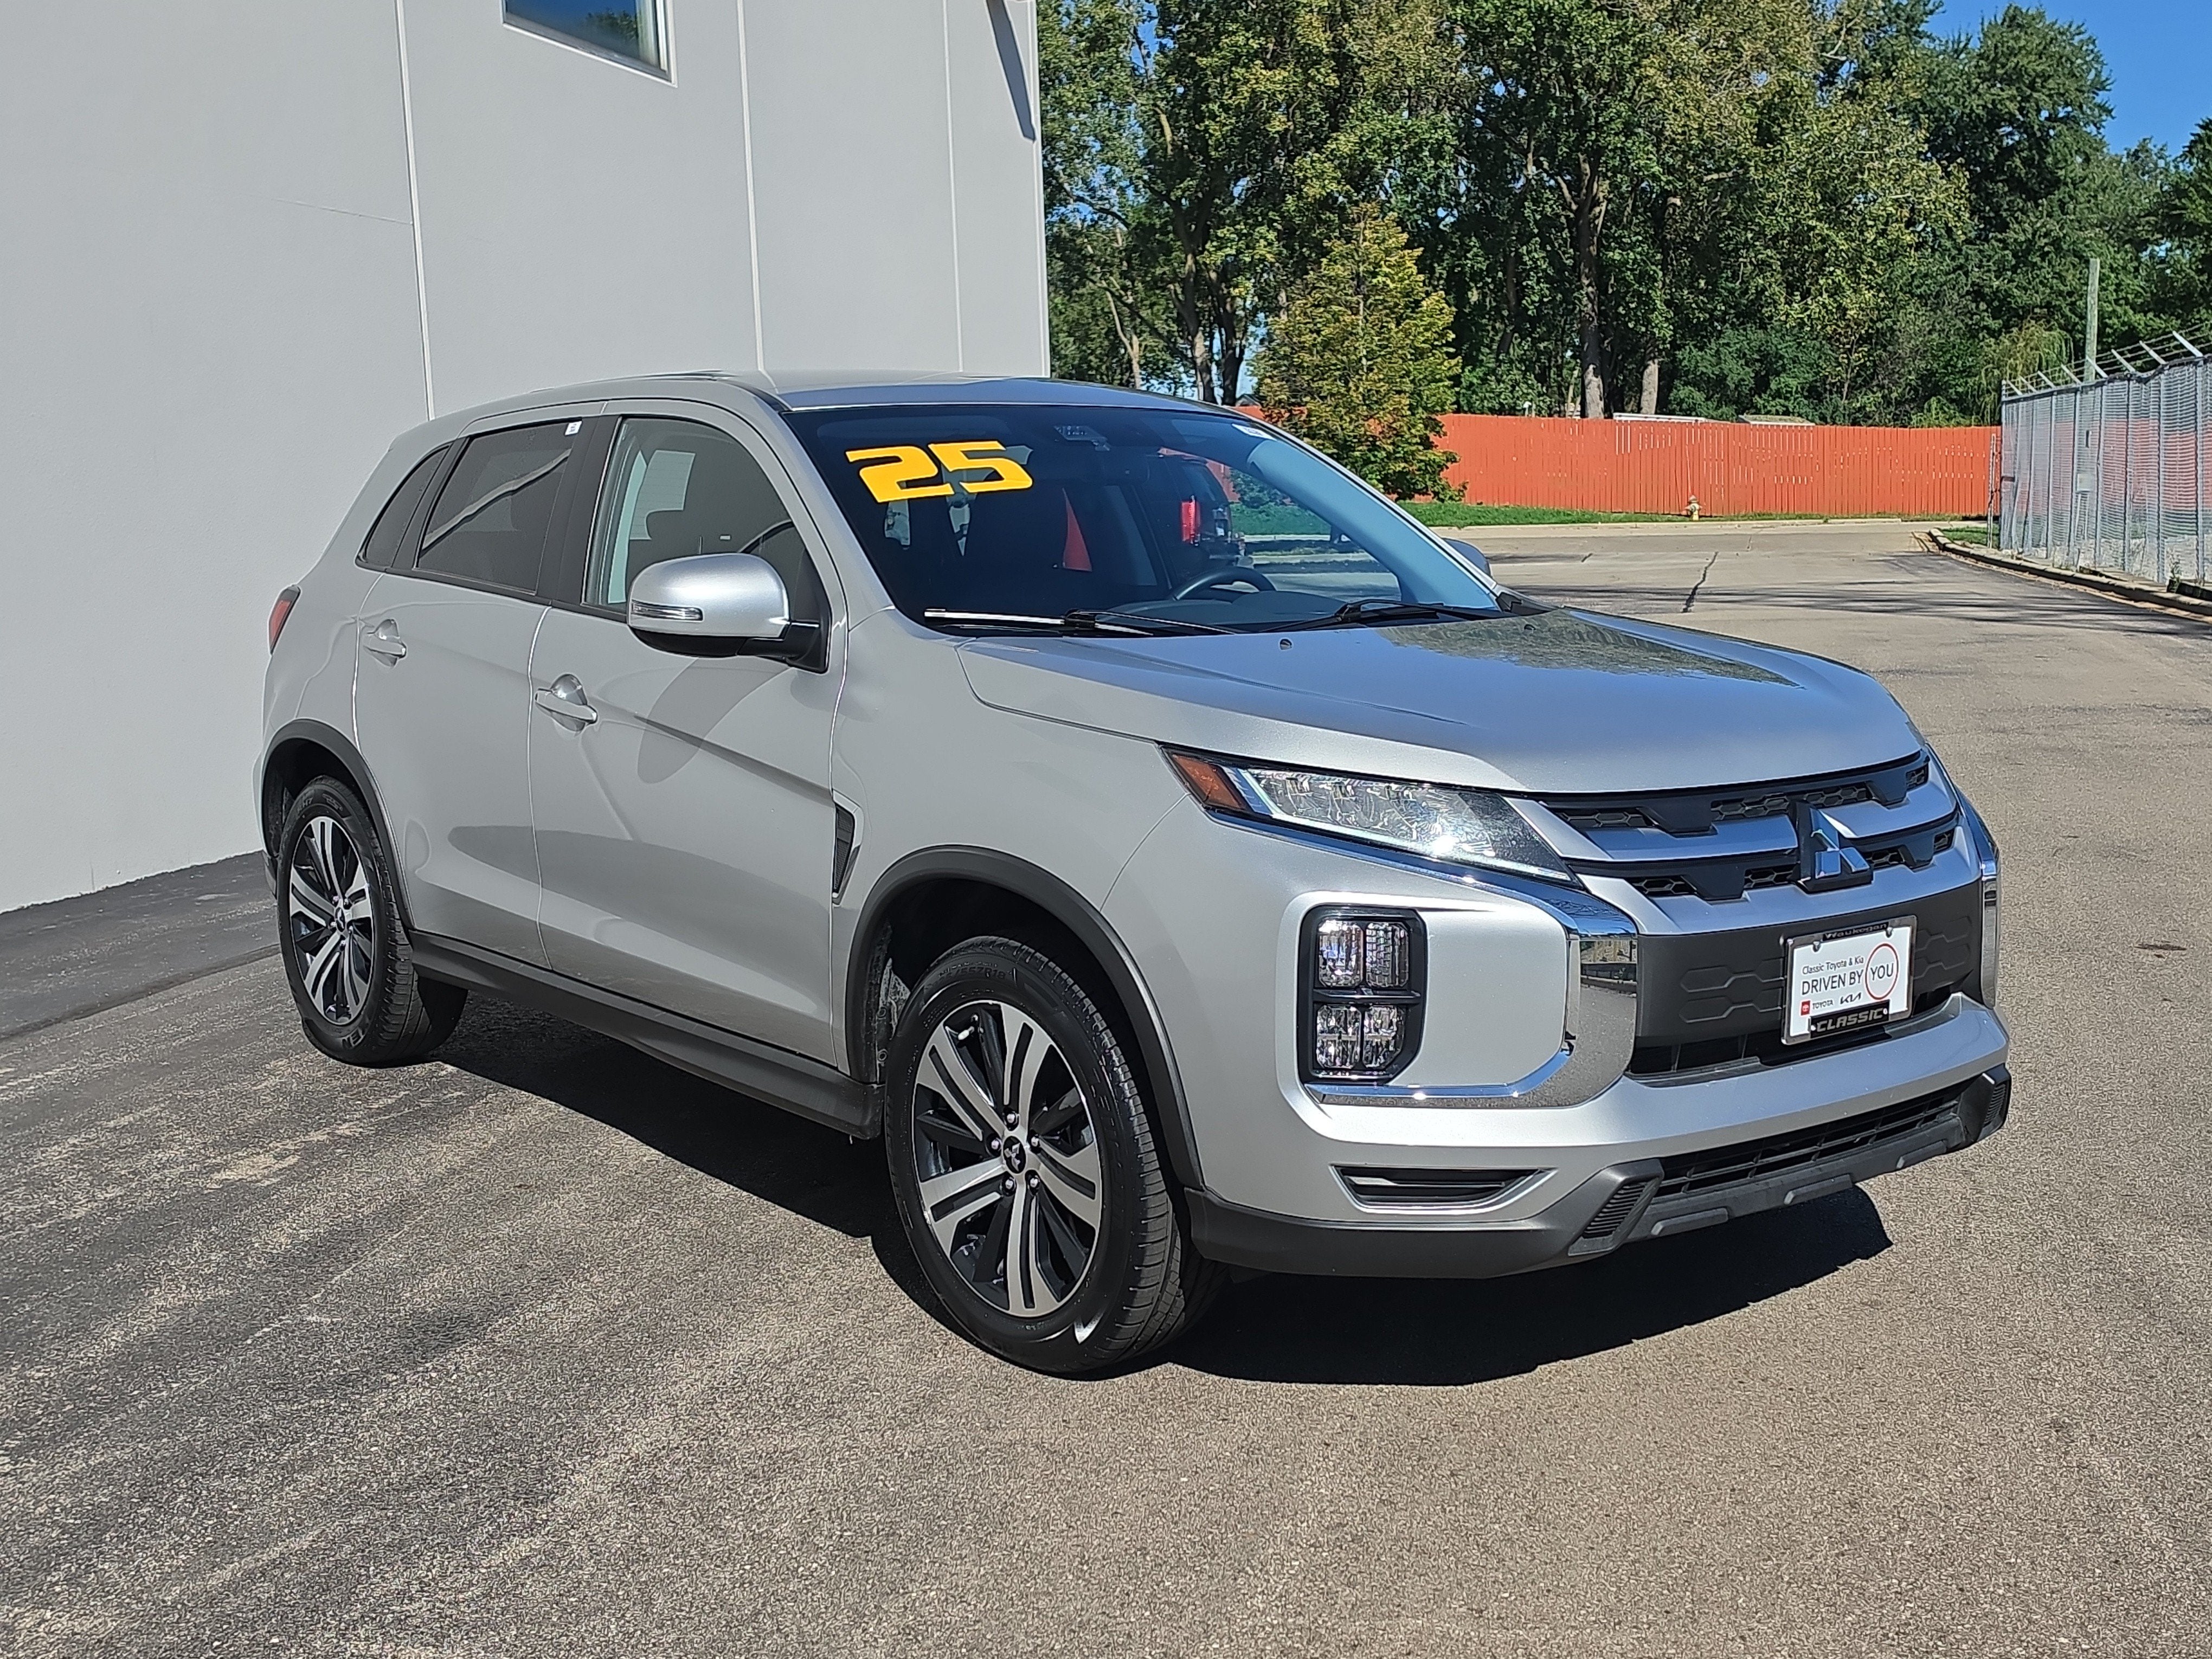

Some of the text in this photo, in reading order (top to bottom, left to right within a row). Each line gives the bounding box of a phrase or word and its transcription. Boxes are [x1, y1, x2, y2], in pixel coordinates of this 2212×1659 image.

[845, 440, 1033, 503] 25
[1802, 962, 1824, 975] Classic
[1825, 960, 1847, 971] Toyota
[1854, 955, 1864, 965] Kia
[1802, 963, 1894, 995] DRIVEN BY YOU
[1812, 999, 1834, 1009] TOYOTA
[1816, 1007, 1884, 1032] CLASSIC
